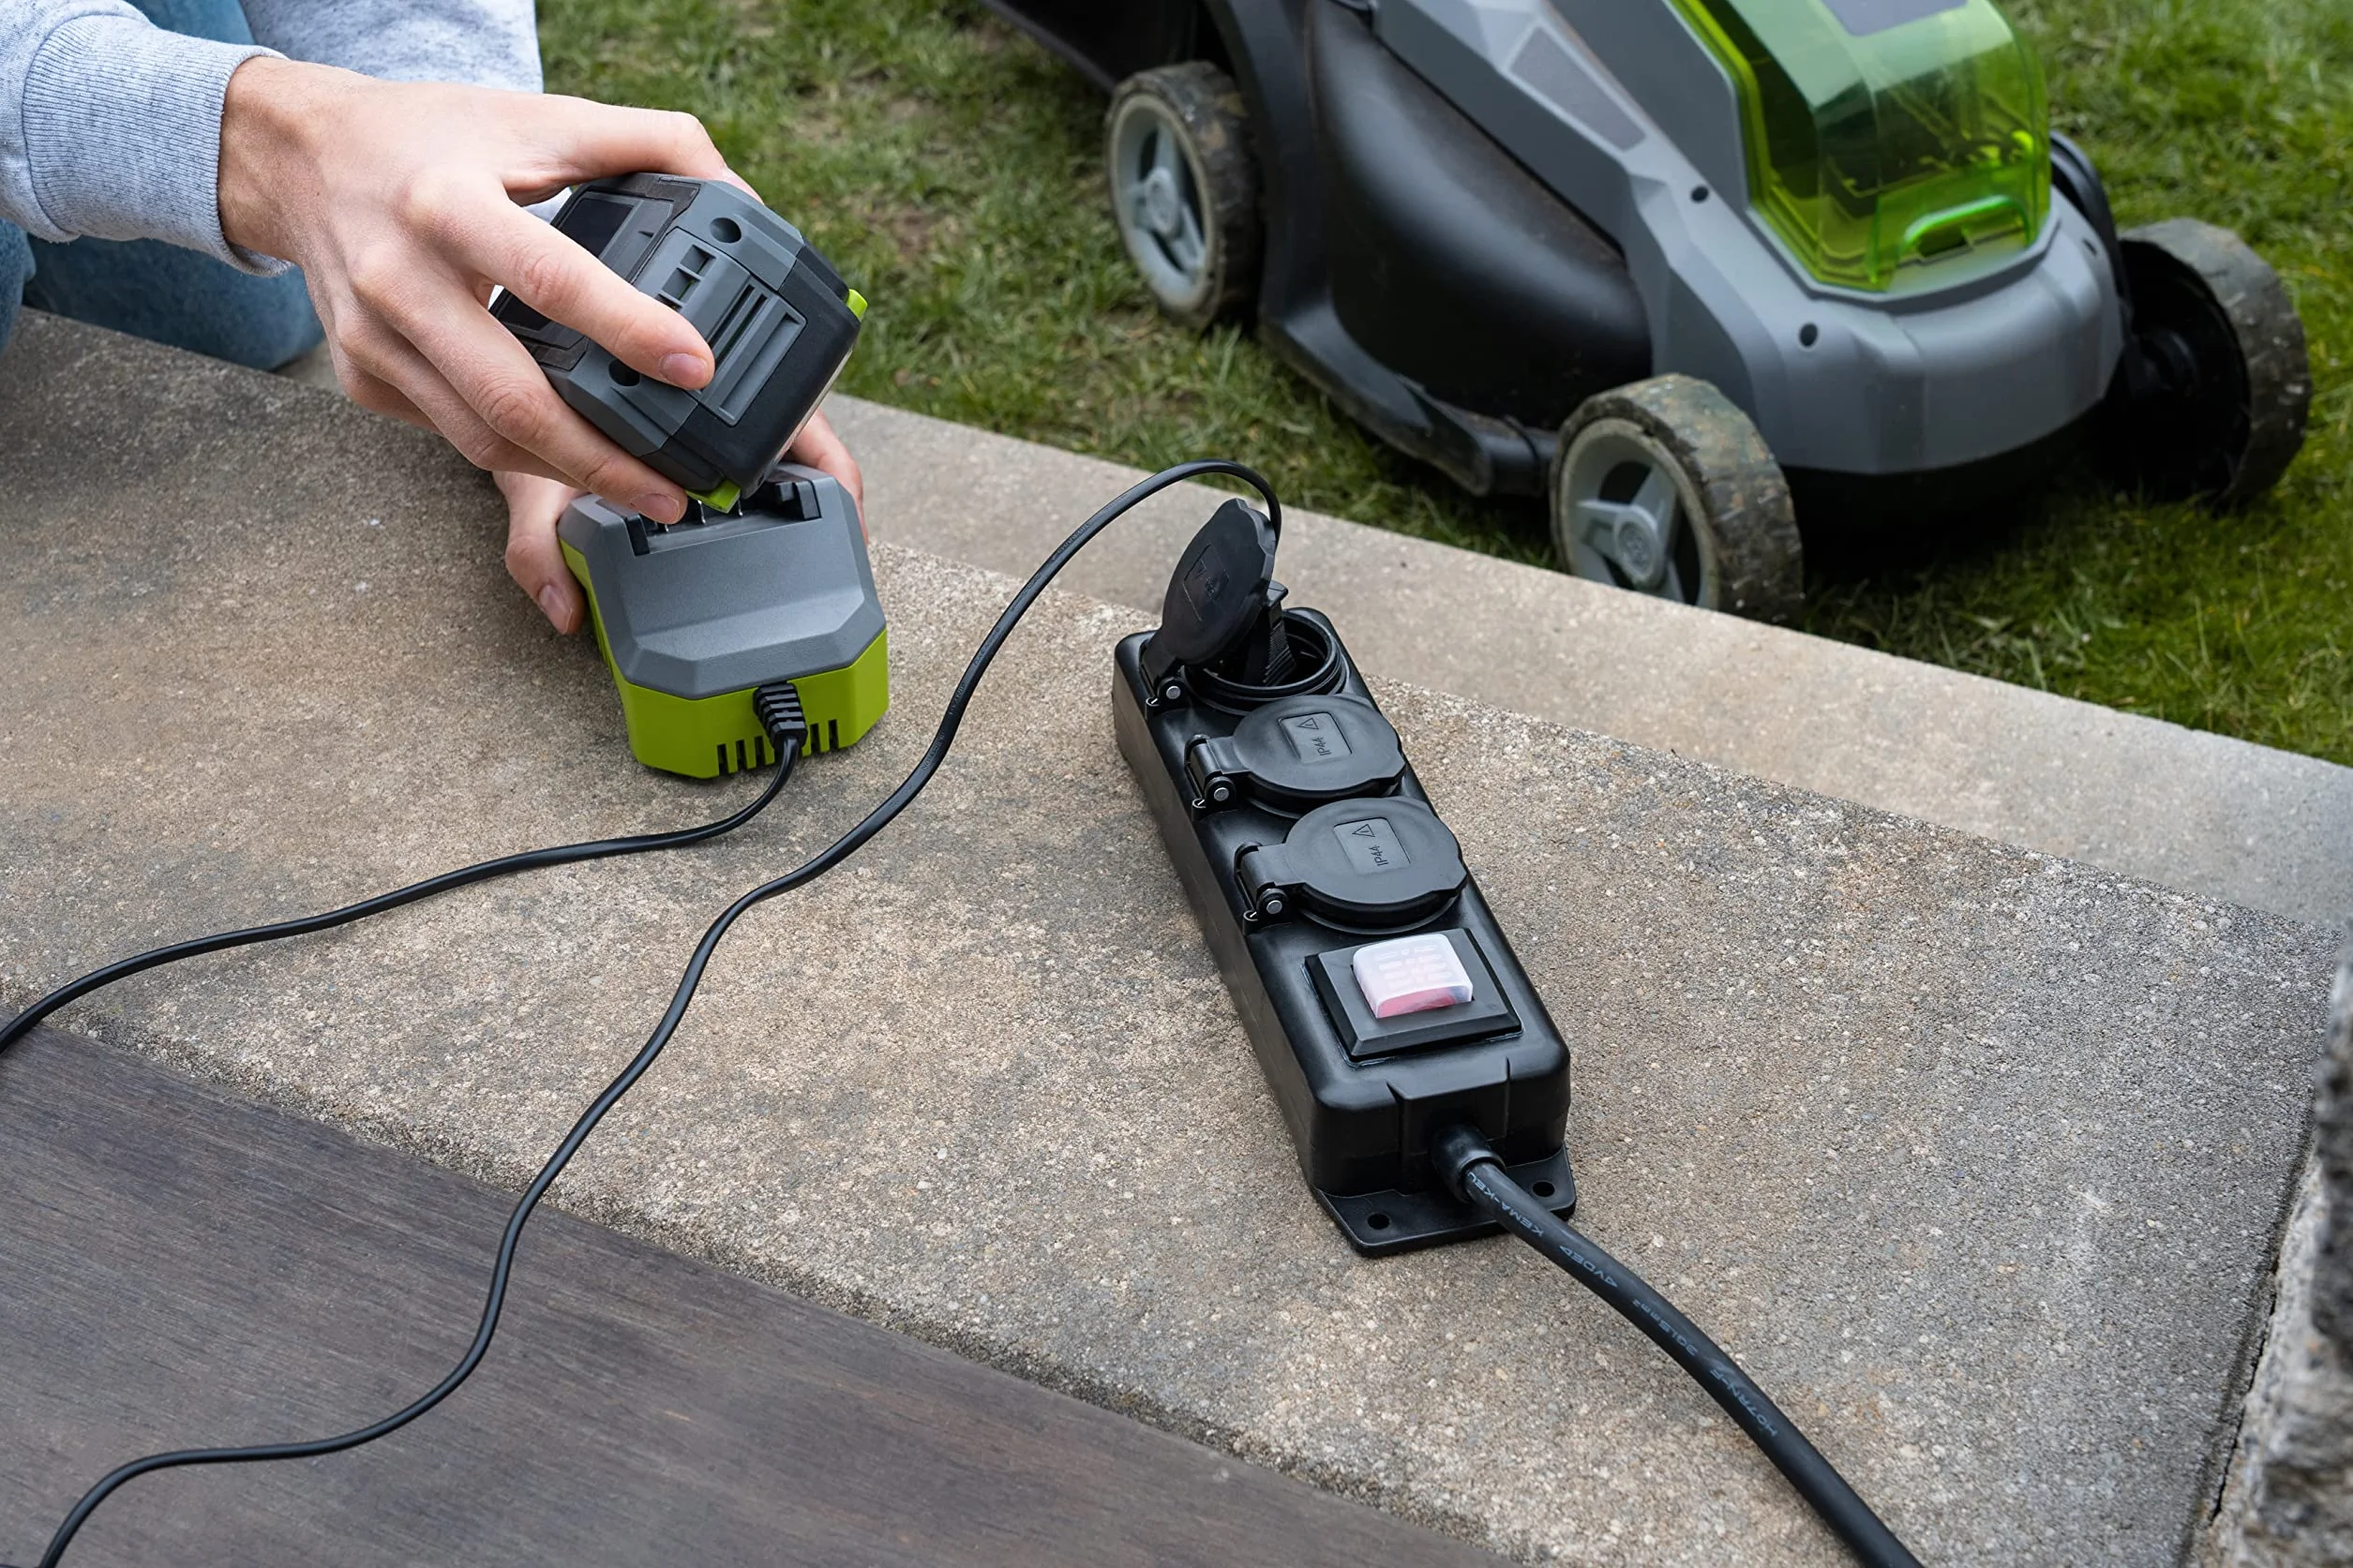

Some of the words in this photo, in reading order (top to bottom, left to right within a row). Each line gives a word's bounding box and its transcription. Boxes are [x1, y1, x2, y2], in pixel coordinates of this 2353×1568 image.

[1311, 737, 1332, 756] IP44
[1369, 844, 1389, 866] IP44
[1466, 1171, 1545, 1237] KEMA-KEU
